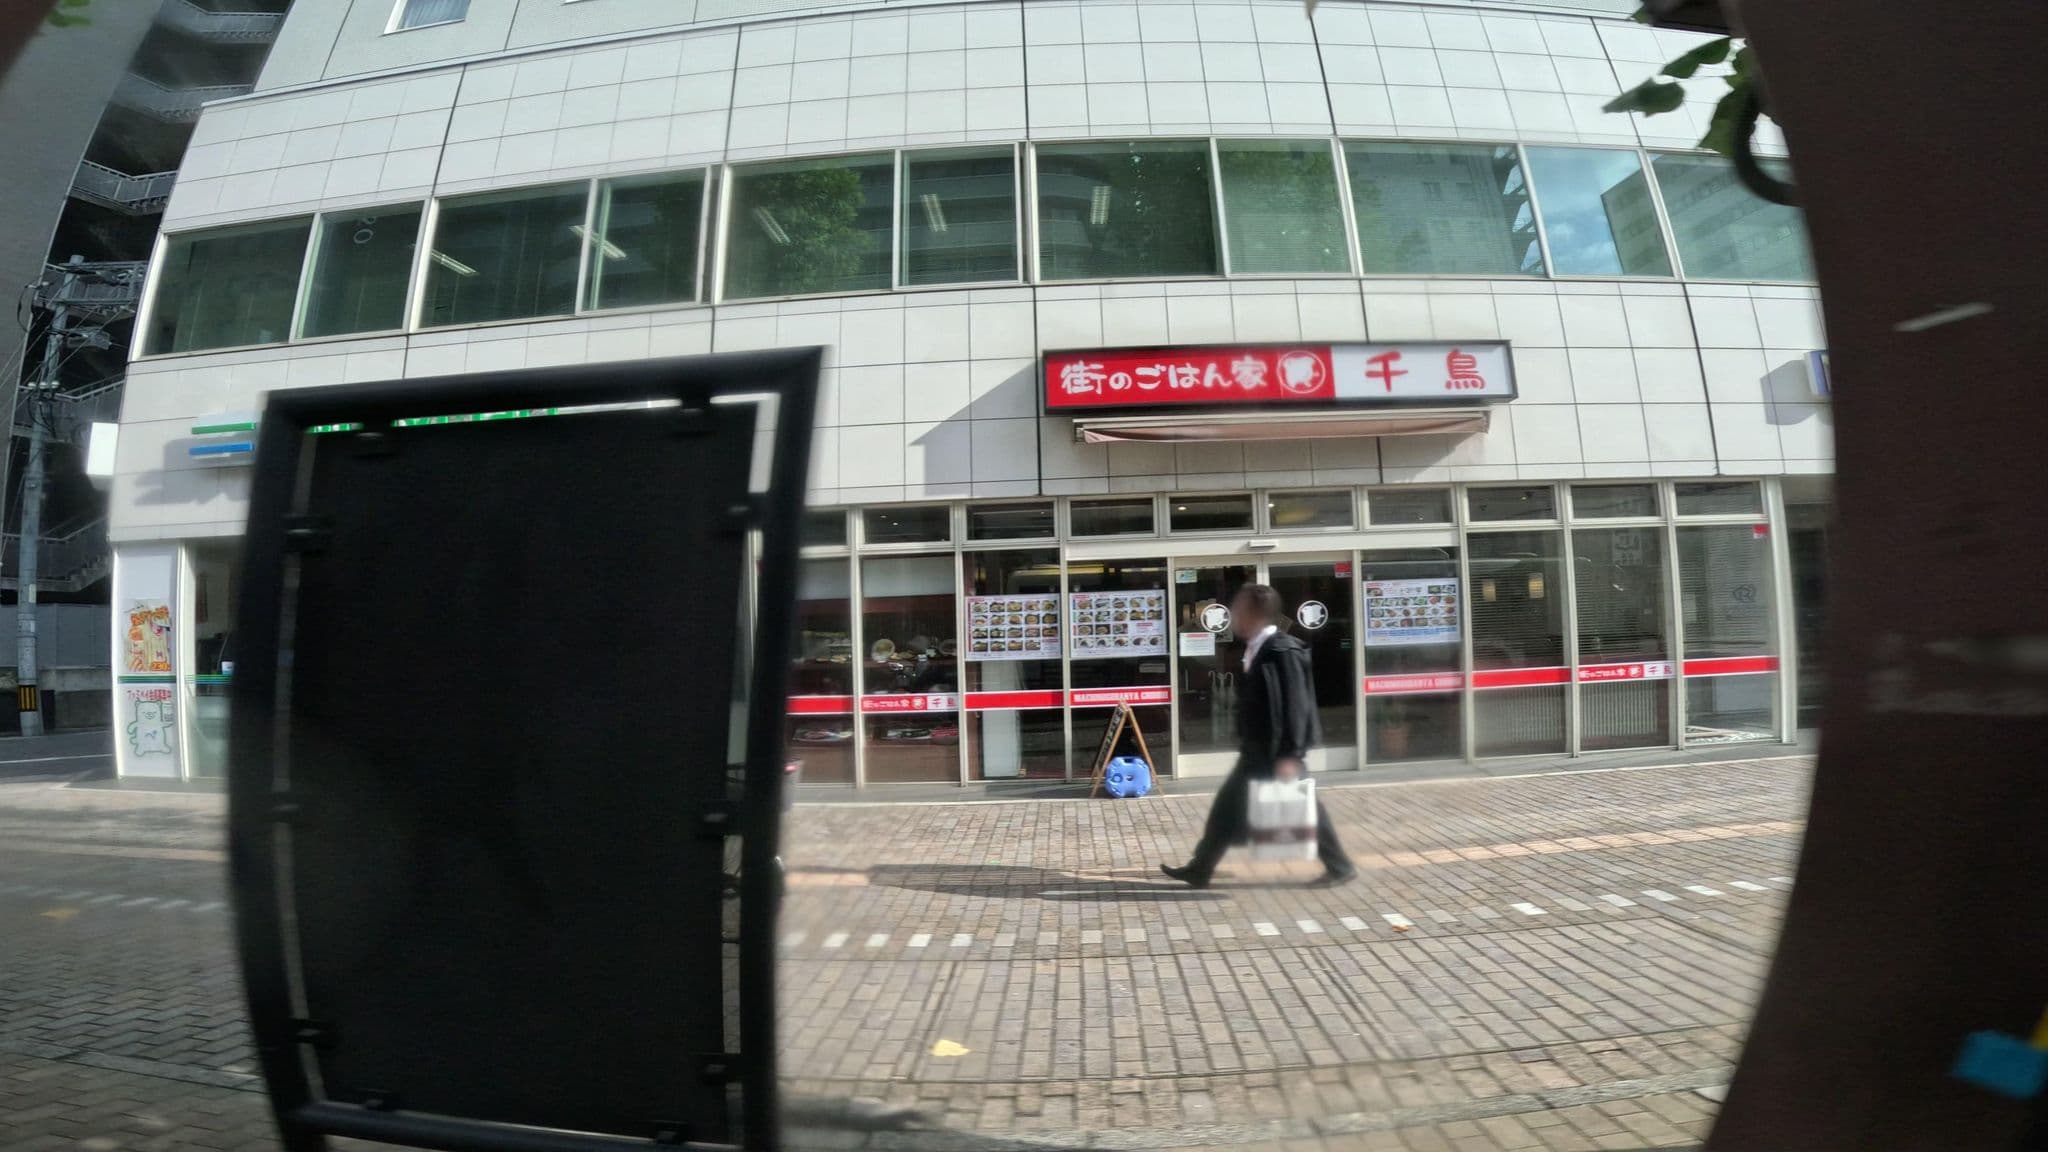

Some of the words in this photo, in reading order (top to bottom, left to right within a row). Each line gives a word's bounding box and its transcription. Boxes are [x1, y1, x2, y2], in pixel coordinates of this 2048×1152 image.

[1061, 355, 1267, 394] 街のごはん家
[1365, 349, 1486, 393] 千鳥
